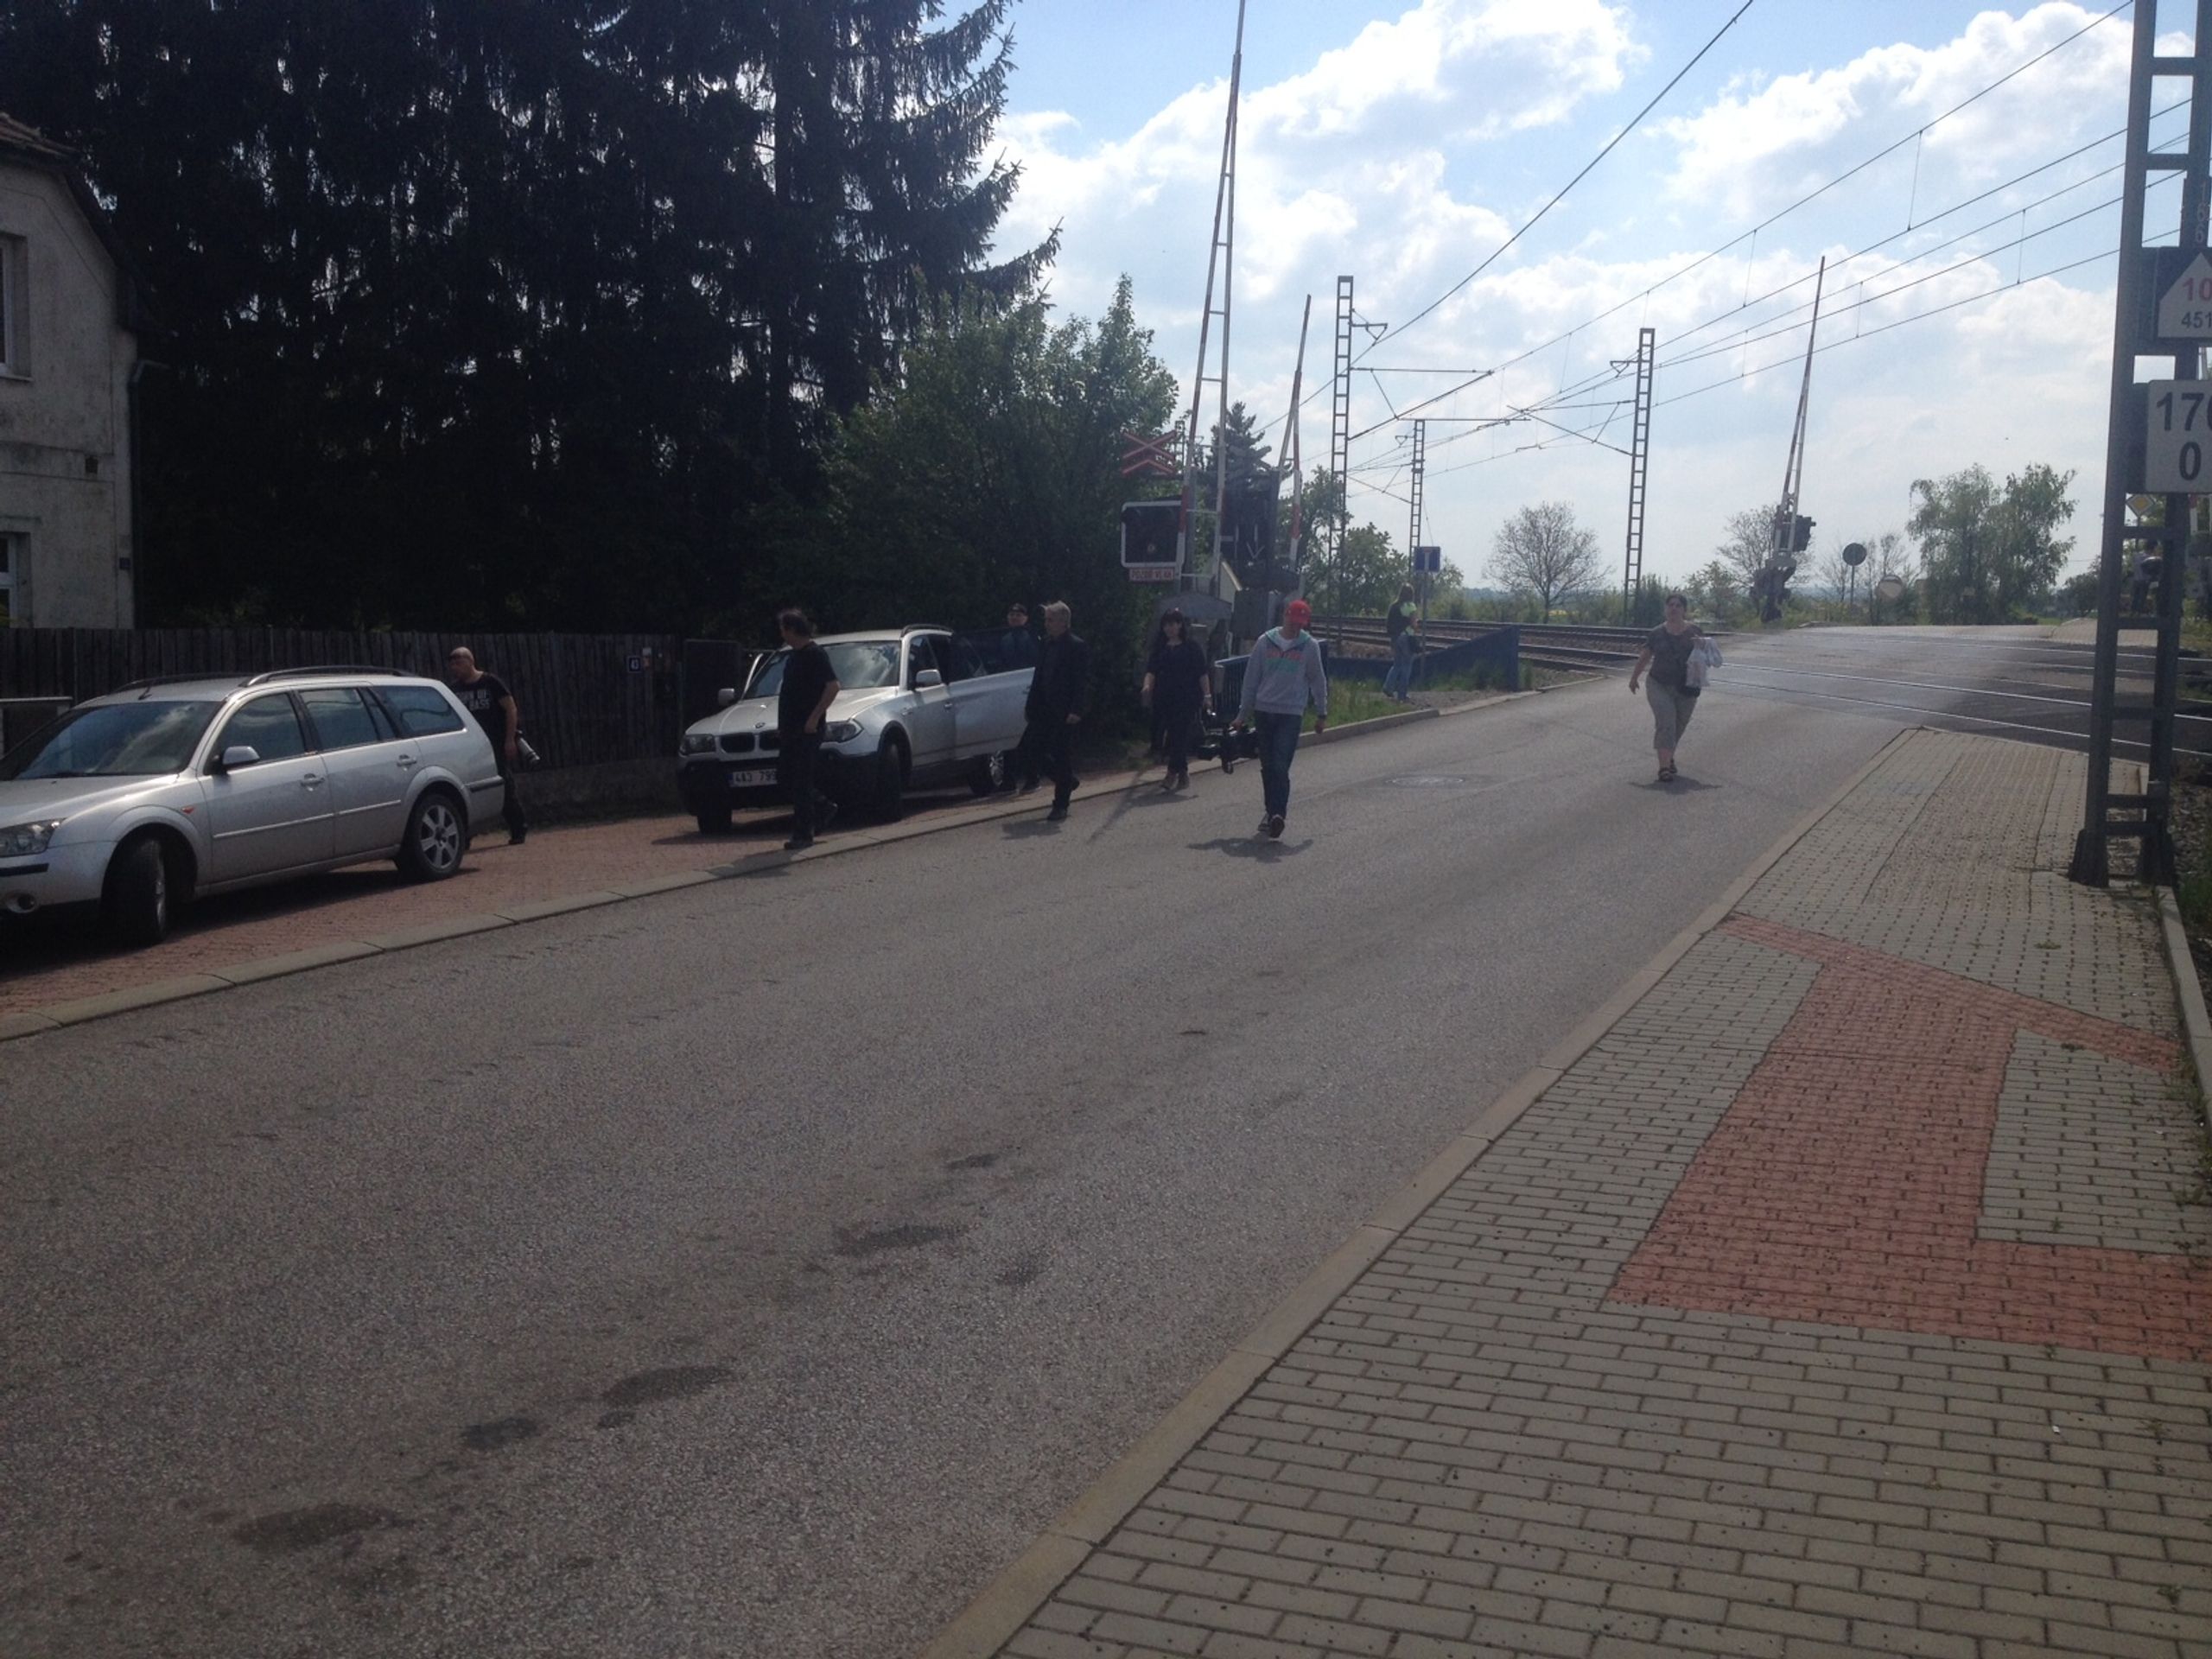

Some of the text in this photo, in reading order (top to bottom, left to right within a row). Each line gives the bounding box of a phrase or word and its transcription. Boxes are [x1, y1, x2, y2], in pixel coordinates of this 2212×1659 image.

[2181, 311, 2212, 328] 451
[2157, 391, 2212, 430] 17
[2178, 442, 2202, 480] 0
